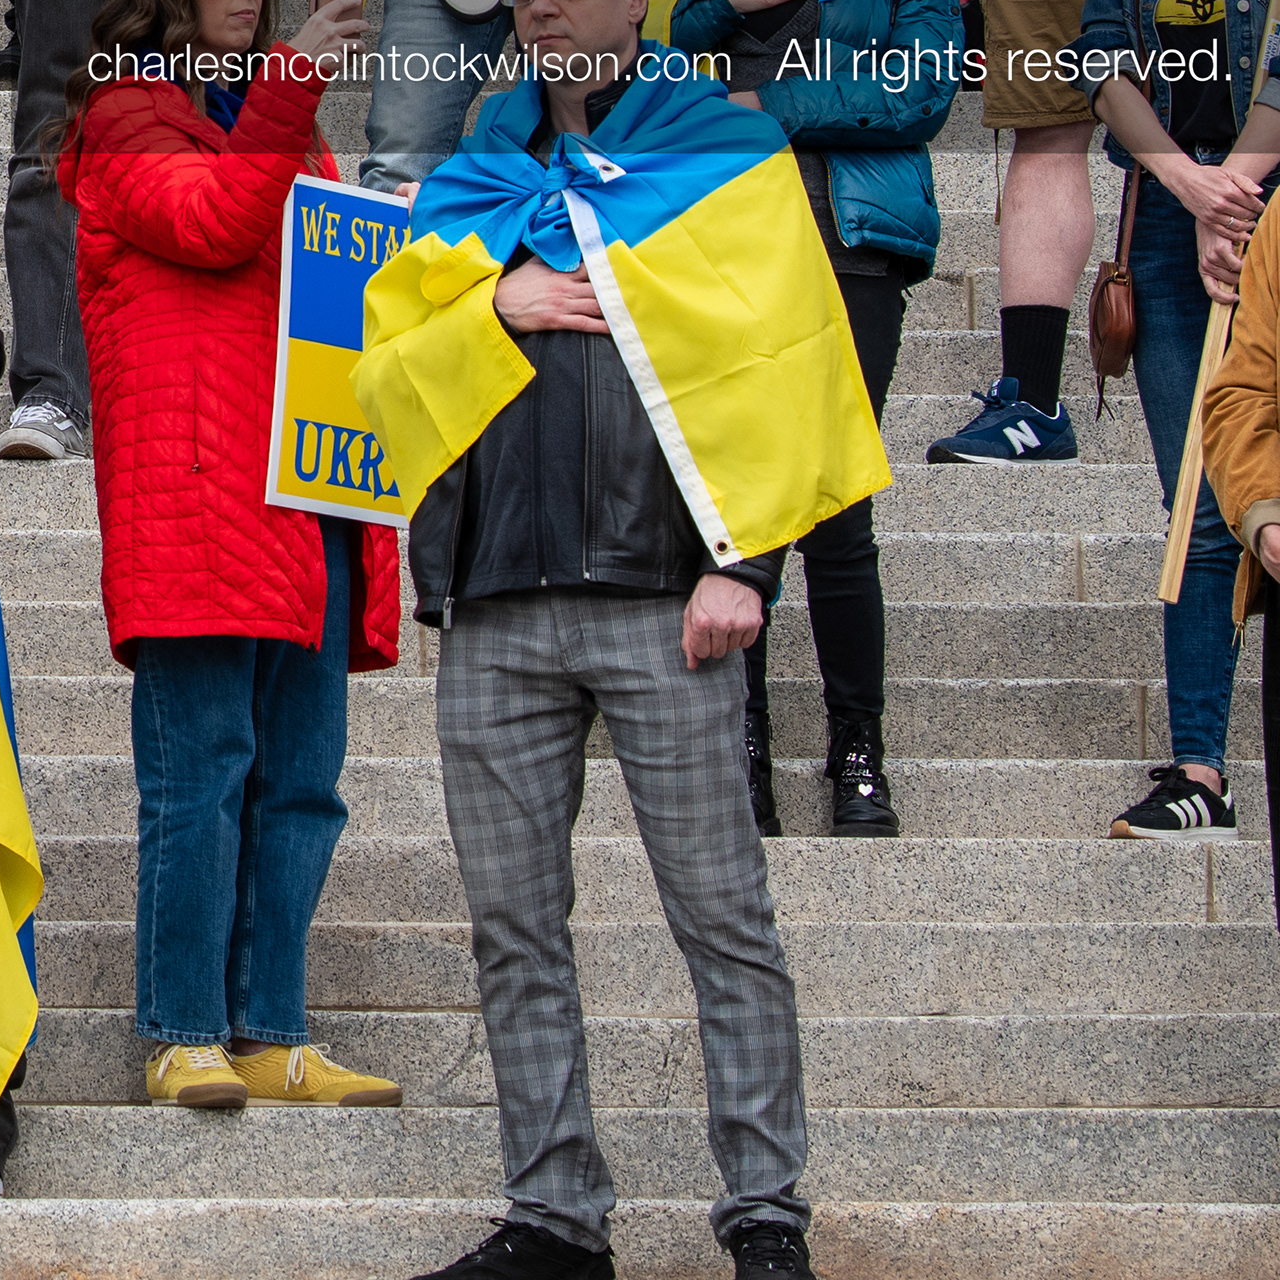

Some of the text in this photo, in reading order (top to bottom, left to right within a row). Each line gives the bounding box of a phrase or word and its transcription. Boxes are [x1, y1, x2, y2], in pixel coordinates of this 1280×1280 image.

[301, 202, 341, 257] WE
[293, 417, 400, 502] UKR
[1002, 419, 1041, 456] N
